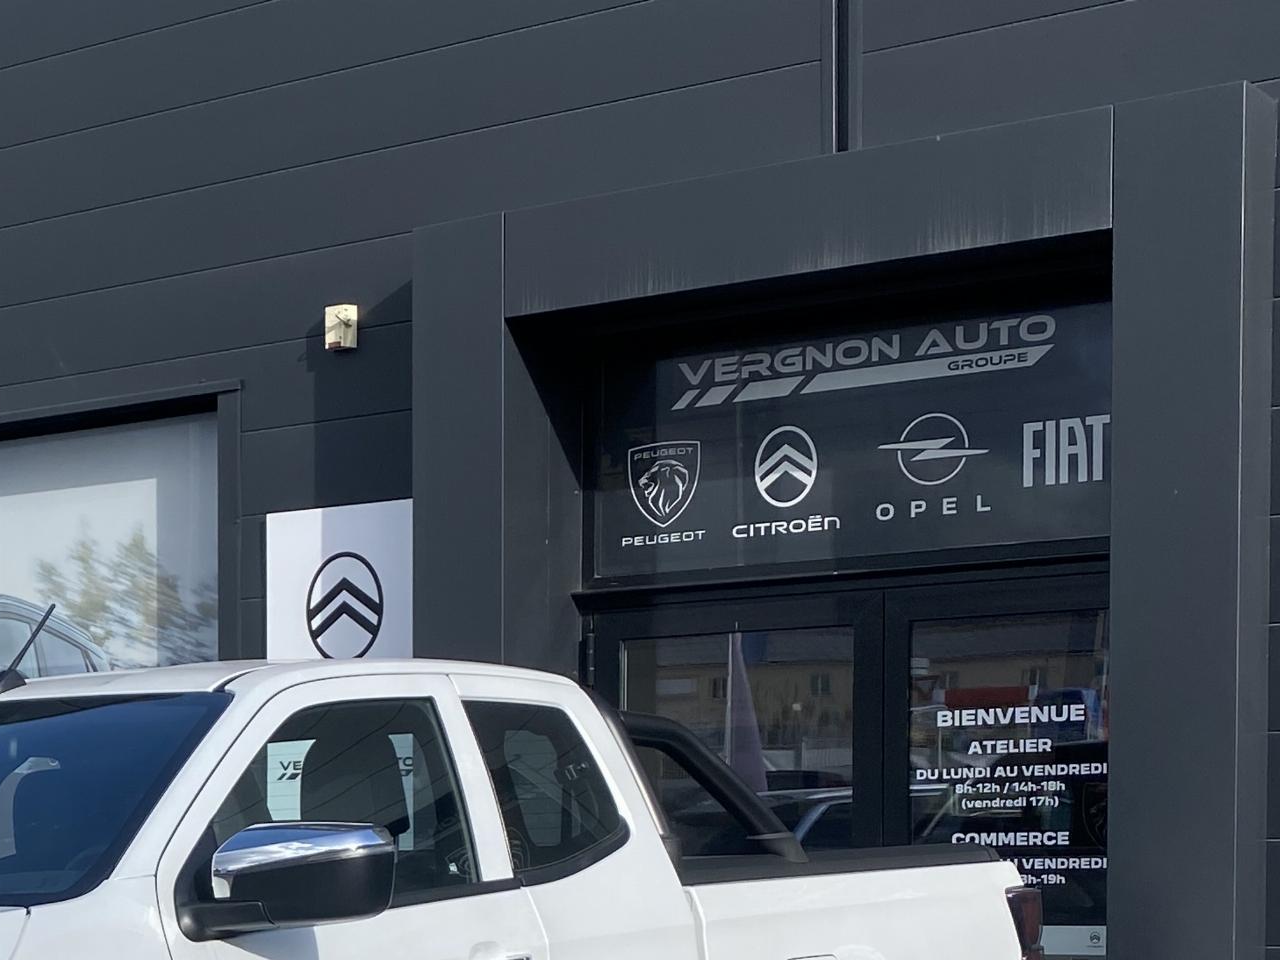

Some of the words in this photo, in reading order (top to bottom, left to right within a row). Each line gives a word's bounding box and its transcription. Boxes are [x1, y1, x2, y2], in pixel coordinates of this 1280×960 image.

[678, 333, 901, 386] VERGNON
[913, 314, 1057, 356] AUTO
[947, 352, 1029, 372] GROUPE
[633, 446, 694, 461] PEUGEOT
[1022, 414, 1112, 488] FIAT
[875, 494, 992, 521] OPEL
[621, 529, 706, 547] PEUGEOT
[936, 704, 1086, 727] BIENVENUE
[967, 738, 1052, 755] ATELIER
[915, 768, 939, 781] DU
[942, 767, 991, 780] LUNDI
[994, 766, 1018, 778] AU
[1022, 763, 1108, 777] VENDREDI
[955, 783, 1000, 794] 8h-12h
[1012, 781, 1066, 792] 14h-18h
[1029, 796, 1059, 808] 17h)
[951, 831, 1070, 846] COMMERCE
[1022, 857, 1108, 869] VENDREDI
